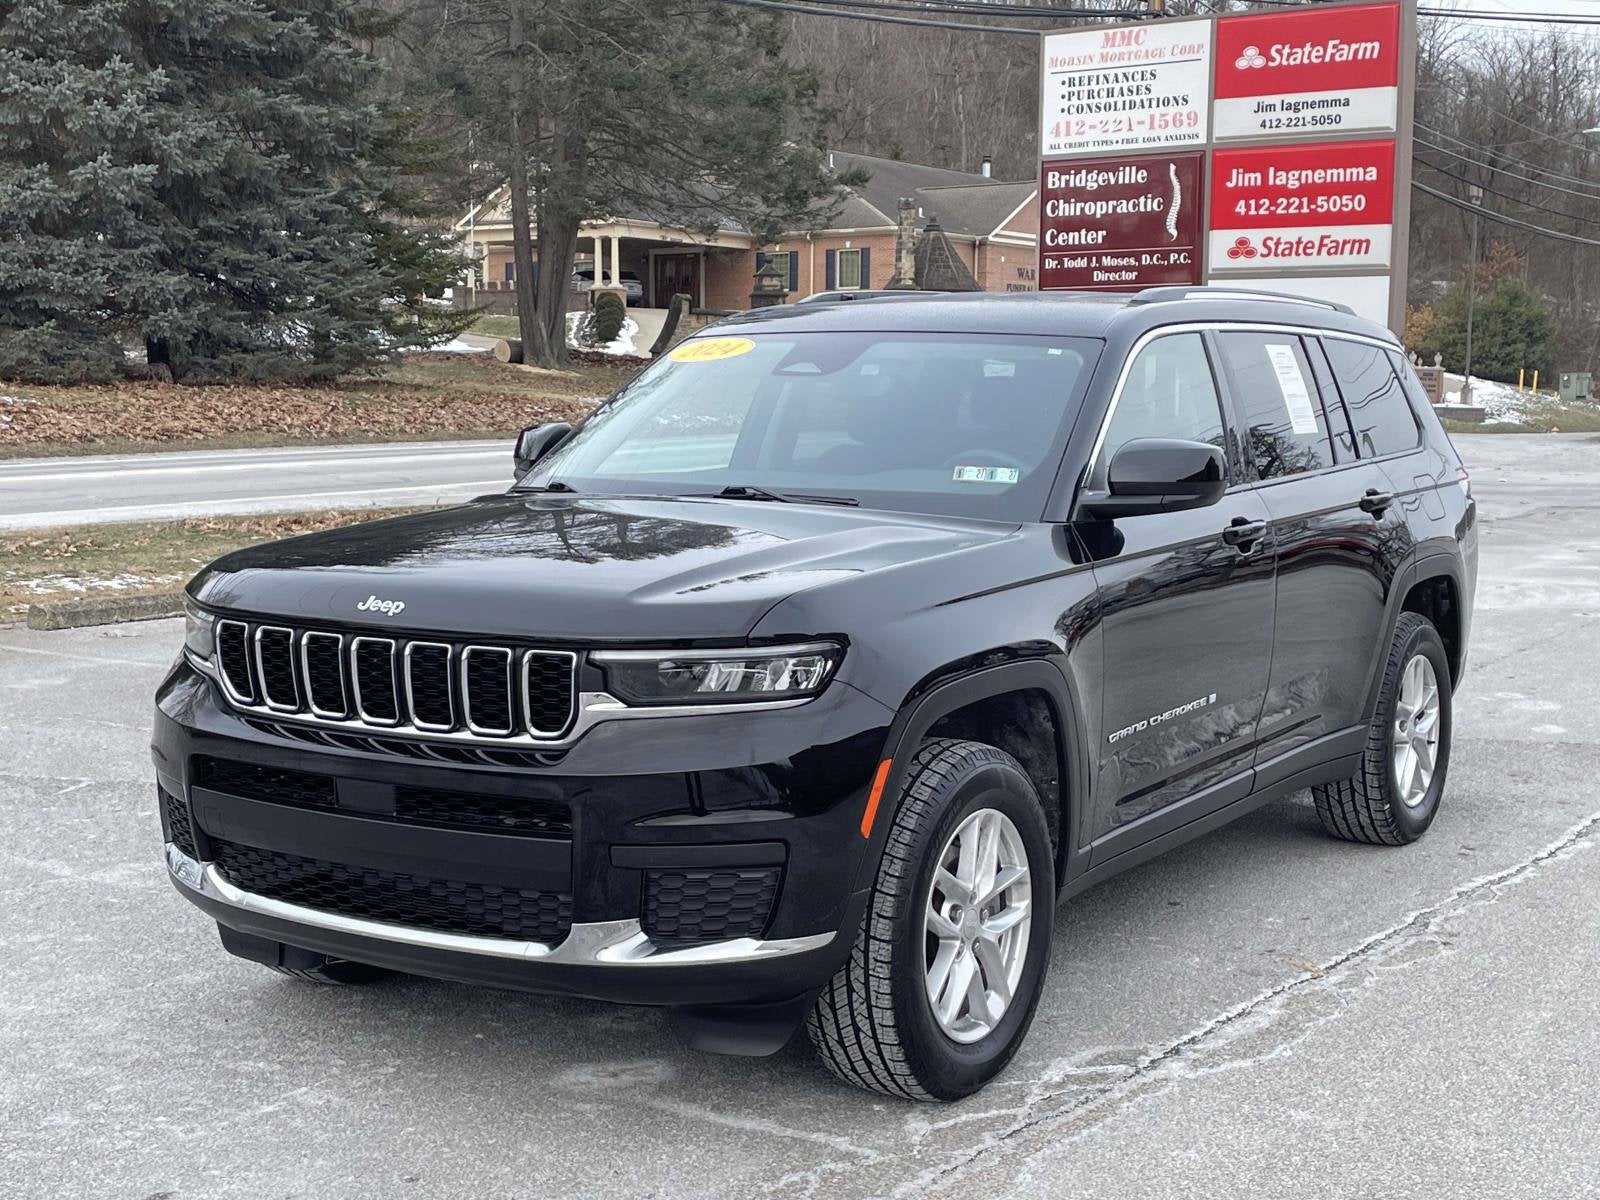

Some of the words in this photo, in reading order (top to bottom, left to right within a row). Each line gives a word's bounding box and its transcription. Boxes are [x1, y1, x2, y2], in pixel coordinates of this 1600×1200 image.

[1100, 28, 1148, 49] MMC
[1098, 47, 1167, 64] MORTGAGE
[1068, 69, 1158, 88] REFINANCES
[1067, 84, 1152, 101] PURCHASES
[1067, 95, 1190, 115] CONSOLIDATIONS
[1253, 100, 1276, 114] Jim
[1280, 97, 1350, 113] Iagnemma
[1051, 111, 1199, 138] 412-221-1569
[1260, 114, 1342, 130] 412-221-5050
[1049, 143, 1062, 151] ALL
[1064, 141, 1090, 150] CREDIT
[1092, 139, 1114, 148] TYPES
[1142, 135, 1162, 144] LOAN
[1163, 133, 1200, 142] ANALYSIS
[1047, 166, 1148, 191] Bridgeville
[1225, 168, 1262, 188] Jim
[1268, 166, 1378, 189] Iagnemma
[1046, 194, 1164, 218] Chiropractic
[1235, 194, 1366, 215] 412-221-5050
[1045, 228, 1107, 247] Center
[1044, 258, 1061, 270] Dr.
[1062, 257, 1088, 268] Todd
[1090, 256, 1099, 268] J.
[1101, 255, 1139, 267] Moses,
[1141, 254, 1168, 266] D.C.,
[1169, 253, 1192, 264] P.C.
[1093, 270, 1138, 282] Director
[357, 595, 405, 617] Jeep
[1108, 720, 1148, 743] GRAND
[1149, 697, 1208, 726] CHEROKEE
